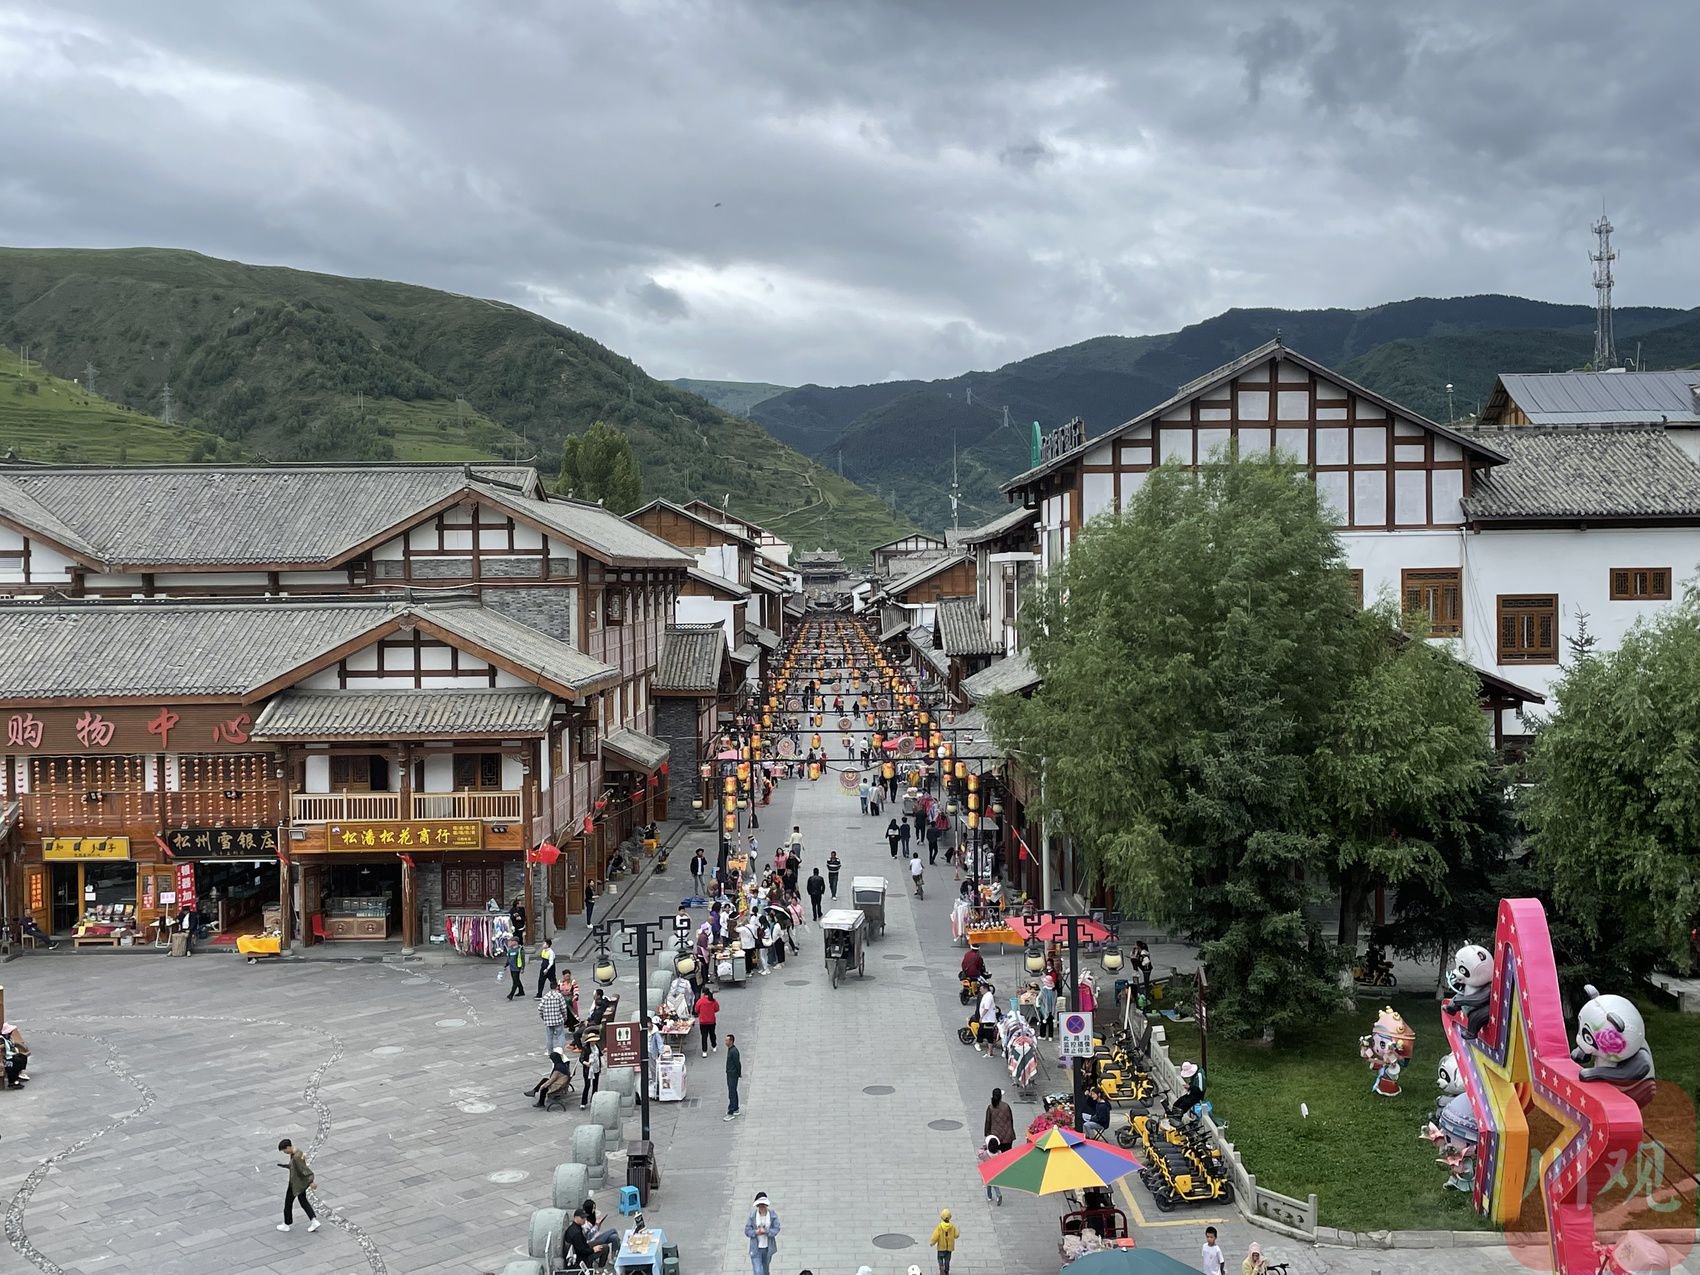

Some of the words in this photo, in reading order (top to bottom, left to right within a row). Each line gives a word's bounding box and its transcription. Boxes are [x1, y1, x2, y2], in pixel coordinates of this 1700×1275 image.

[7, 707, 251, 749] 购物中心
[172, 830, 275, 852] 松州雪银庄
[342, 827, 450, 846] 松潘松花商行
